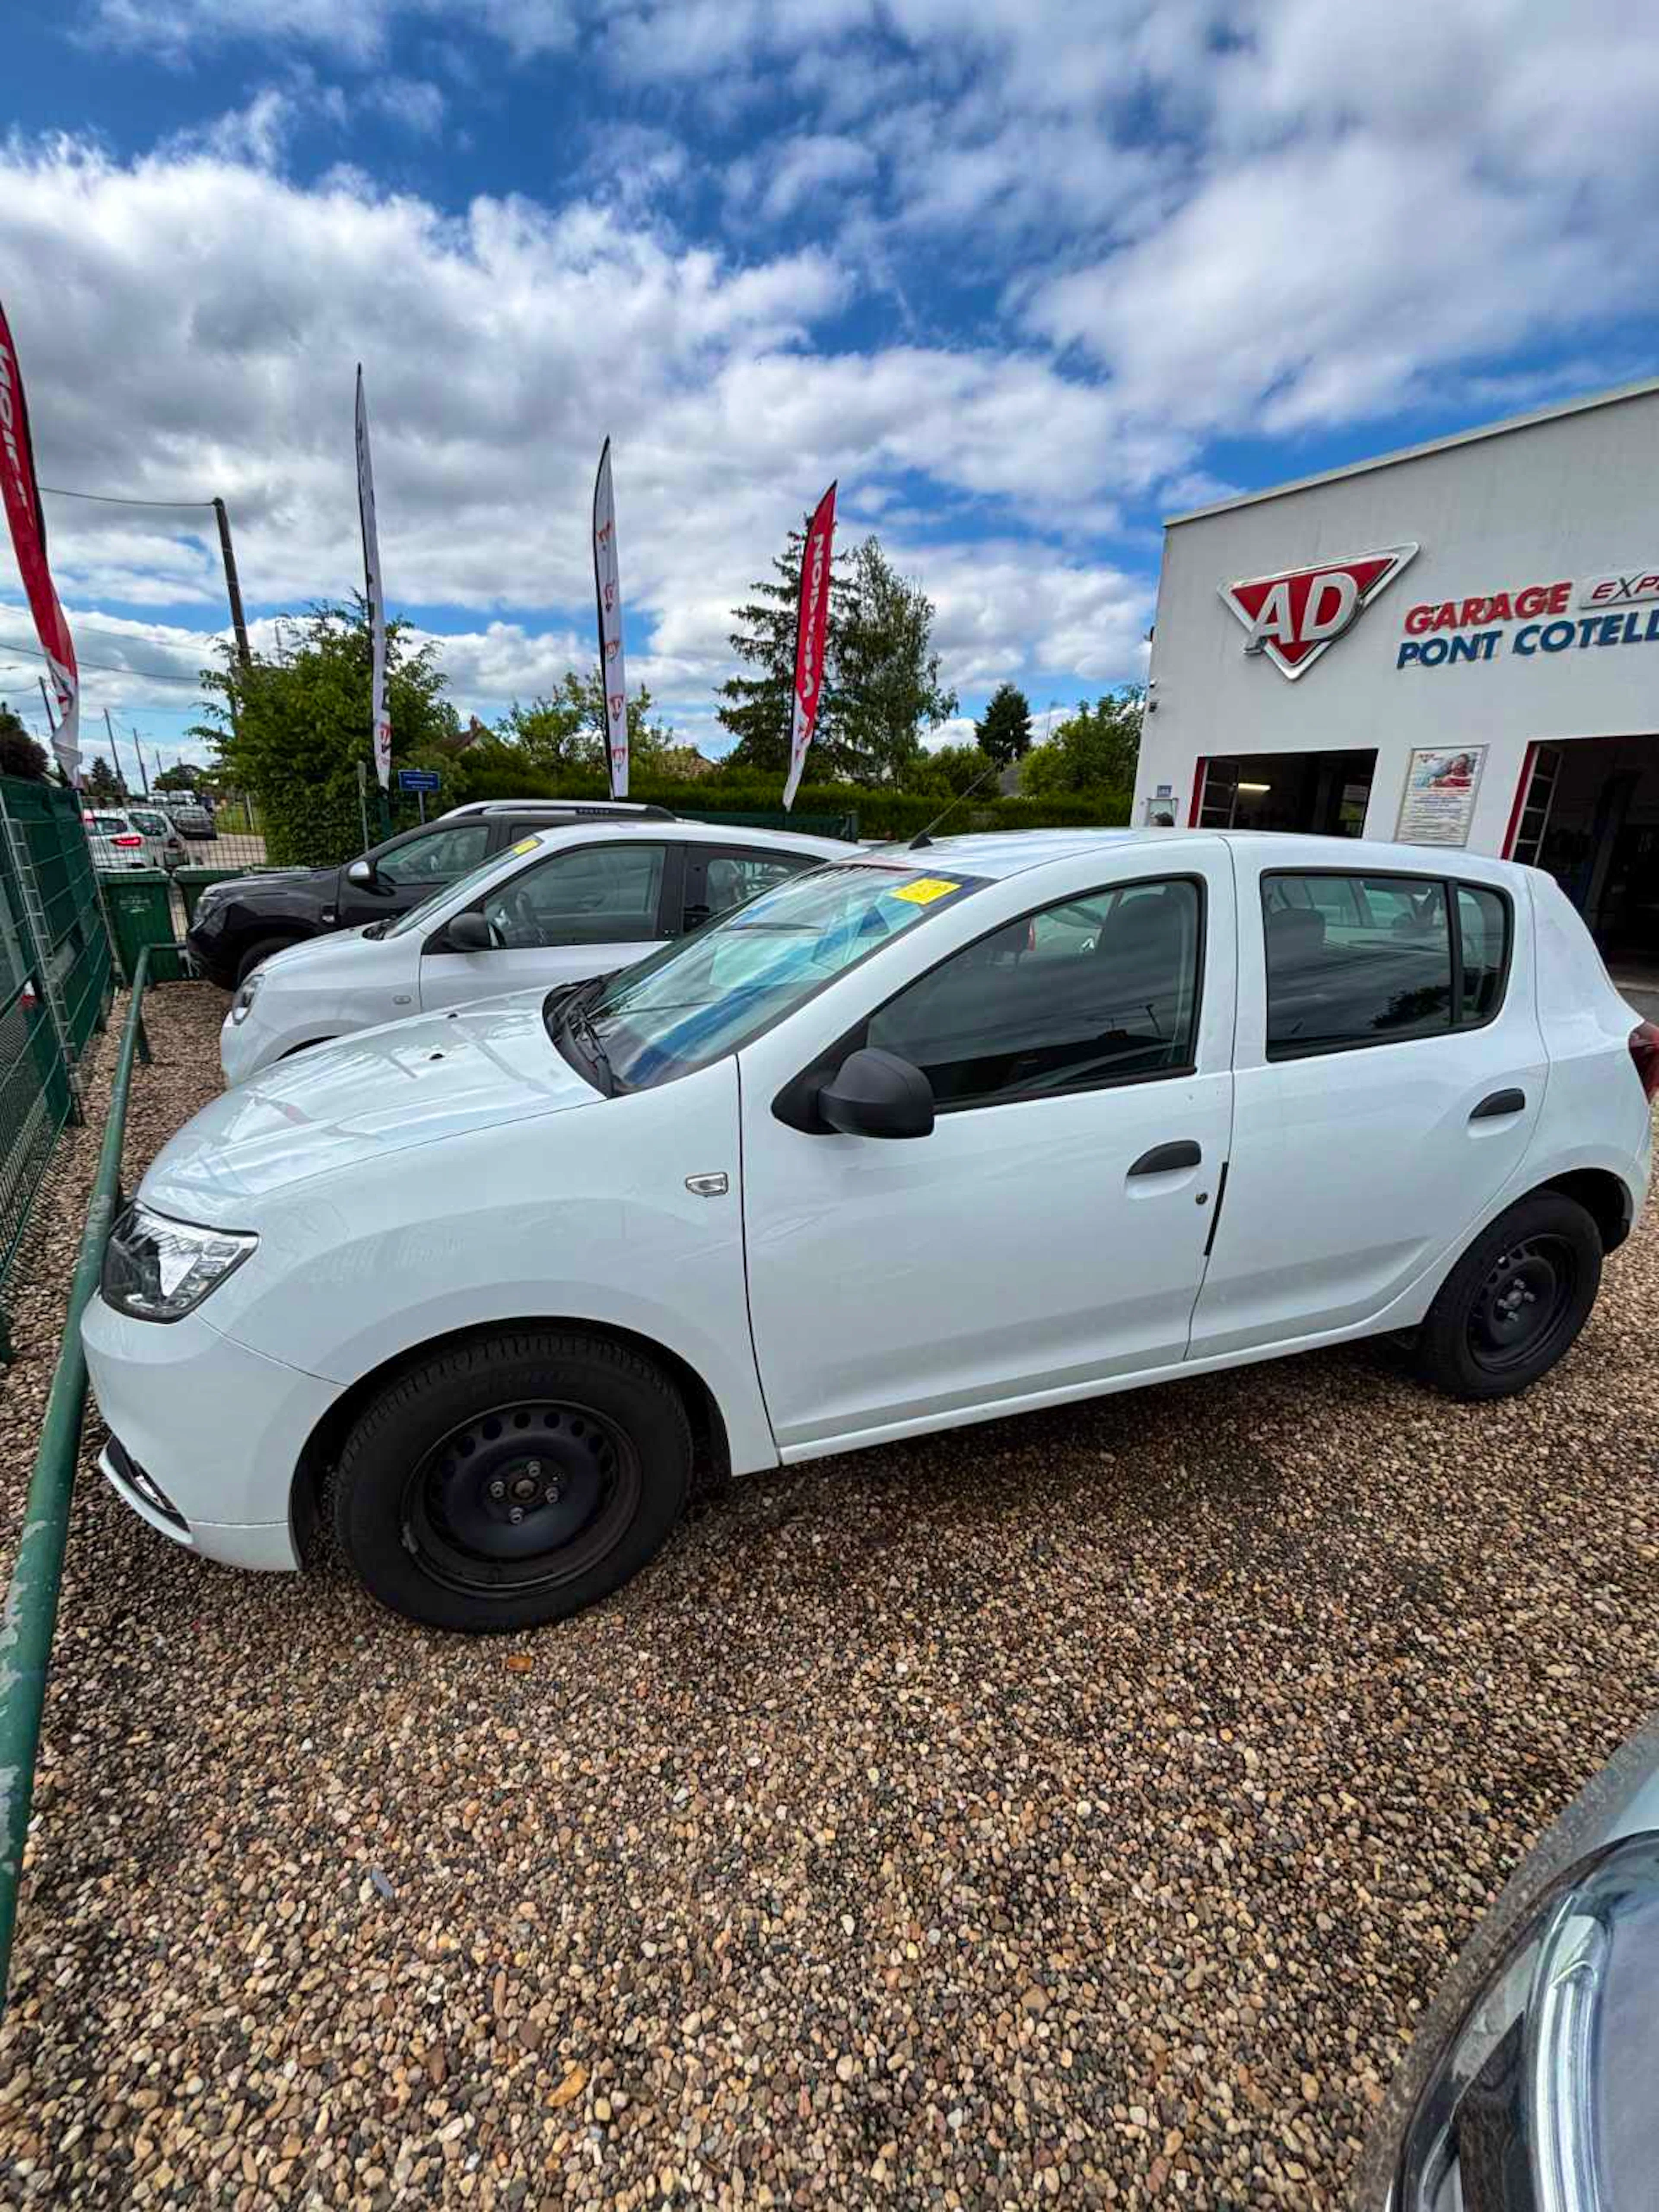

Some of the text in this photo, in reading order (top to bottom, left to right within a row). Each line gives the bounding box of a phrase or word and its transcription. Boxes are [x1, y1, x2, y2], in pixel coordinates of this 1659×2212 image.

[1243, 572, 1358, 653] AD
[1404, 570, 1659, 635] GARAGE EXP
[1396, 609, 1659, 669] PONT COTELL
